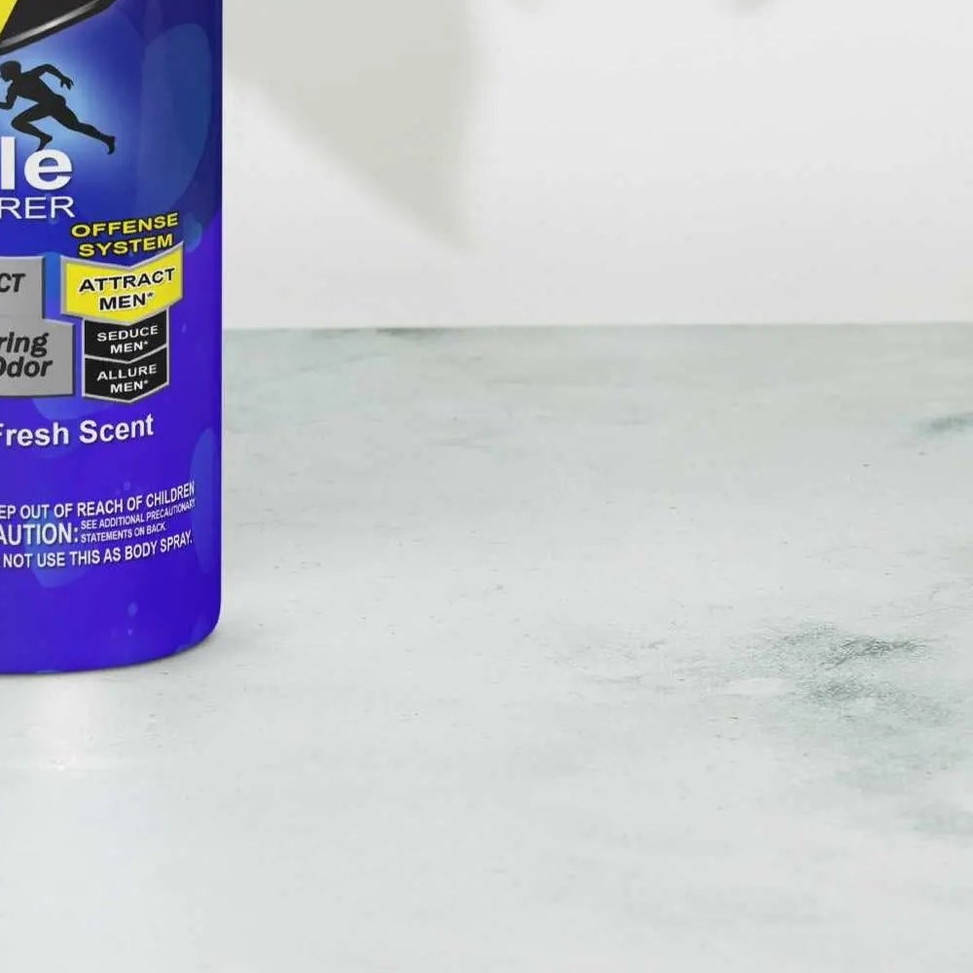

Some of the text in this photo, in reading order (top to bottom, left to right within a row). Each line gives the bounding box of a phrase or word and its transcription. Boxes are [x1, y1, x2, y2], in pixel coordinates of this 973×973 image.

[71, 213, 180, 239] OFFENSE
[79, 233, 174, 258] SYSTEM
[79, 267, 176, 292] ATTRACT
[97, 325, 159, 343] SEDUCE
[97, 364, 158, 382] ALLURE
[79, 413, 154, 444] Scent
[20, 504, 50, 520] OUT
[53, 503, 73, 518] OF
[77, 499, 124, 517] REACH
[127, 494, 143, 511] OF
[145, 480, 195, 509] CHILDREN
[80, 519, 97, 530] SEE
[99, 514, 145, 529] ADDITIONAL
[80, 530, 133, 543] STATEMENTS
[134, 527, 145, 538] ON
[3, 552, 33, 568] NOT
[37, 552, 65, 568] USE
[70, 550, 100, 566] THIS
[103, 547, 122, 564] AS
[125, 540, 158, 561] BODY
[160, 528, 193, 554] SPRAY.
